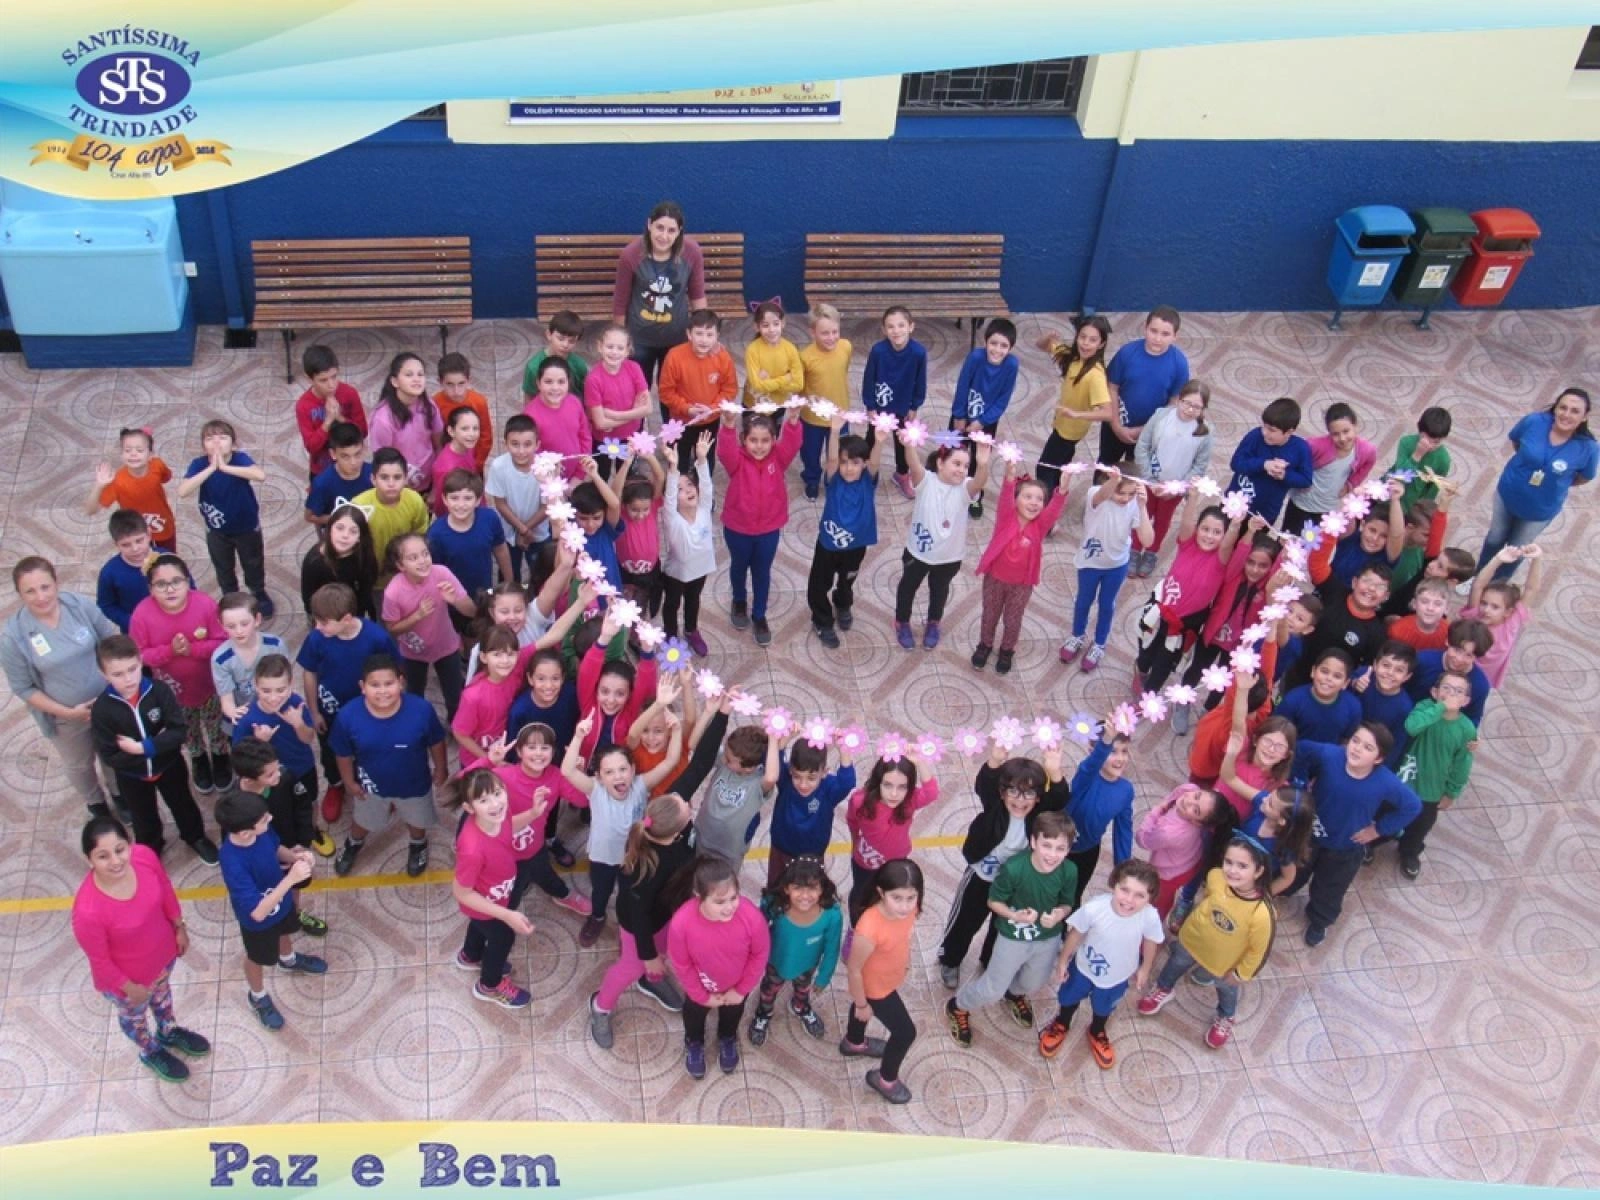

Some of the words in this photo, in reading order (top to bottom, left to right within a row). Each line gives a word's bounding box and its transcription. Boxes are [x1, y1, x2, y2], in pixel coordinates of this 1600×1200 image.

[714, 89, 734, 98] PAZ
[751, 86, 772, 97] BEM
[555, 107, 602, 115] FRANCISCANO
[645, 107, 678, 115] TRINDADE
